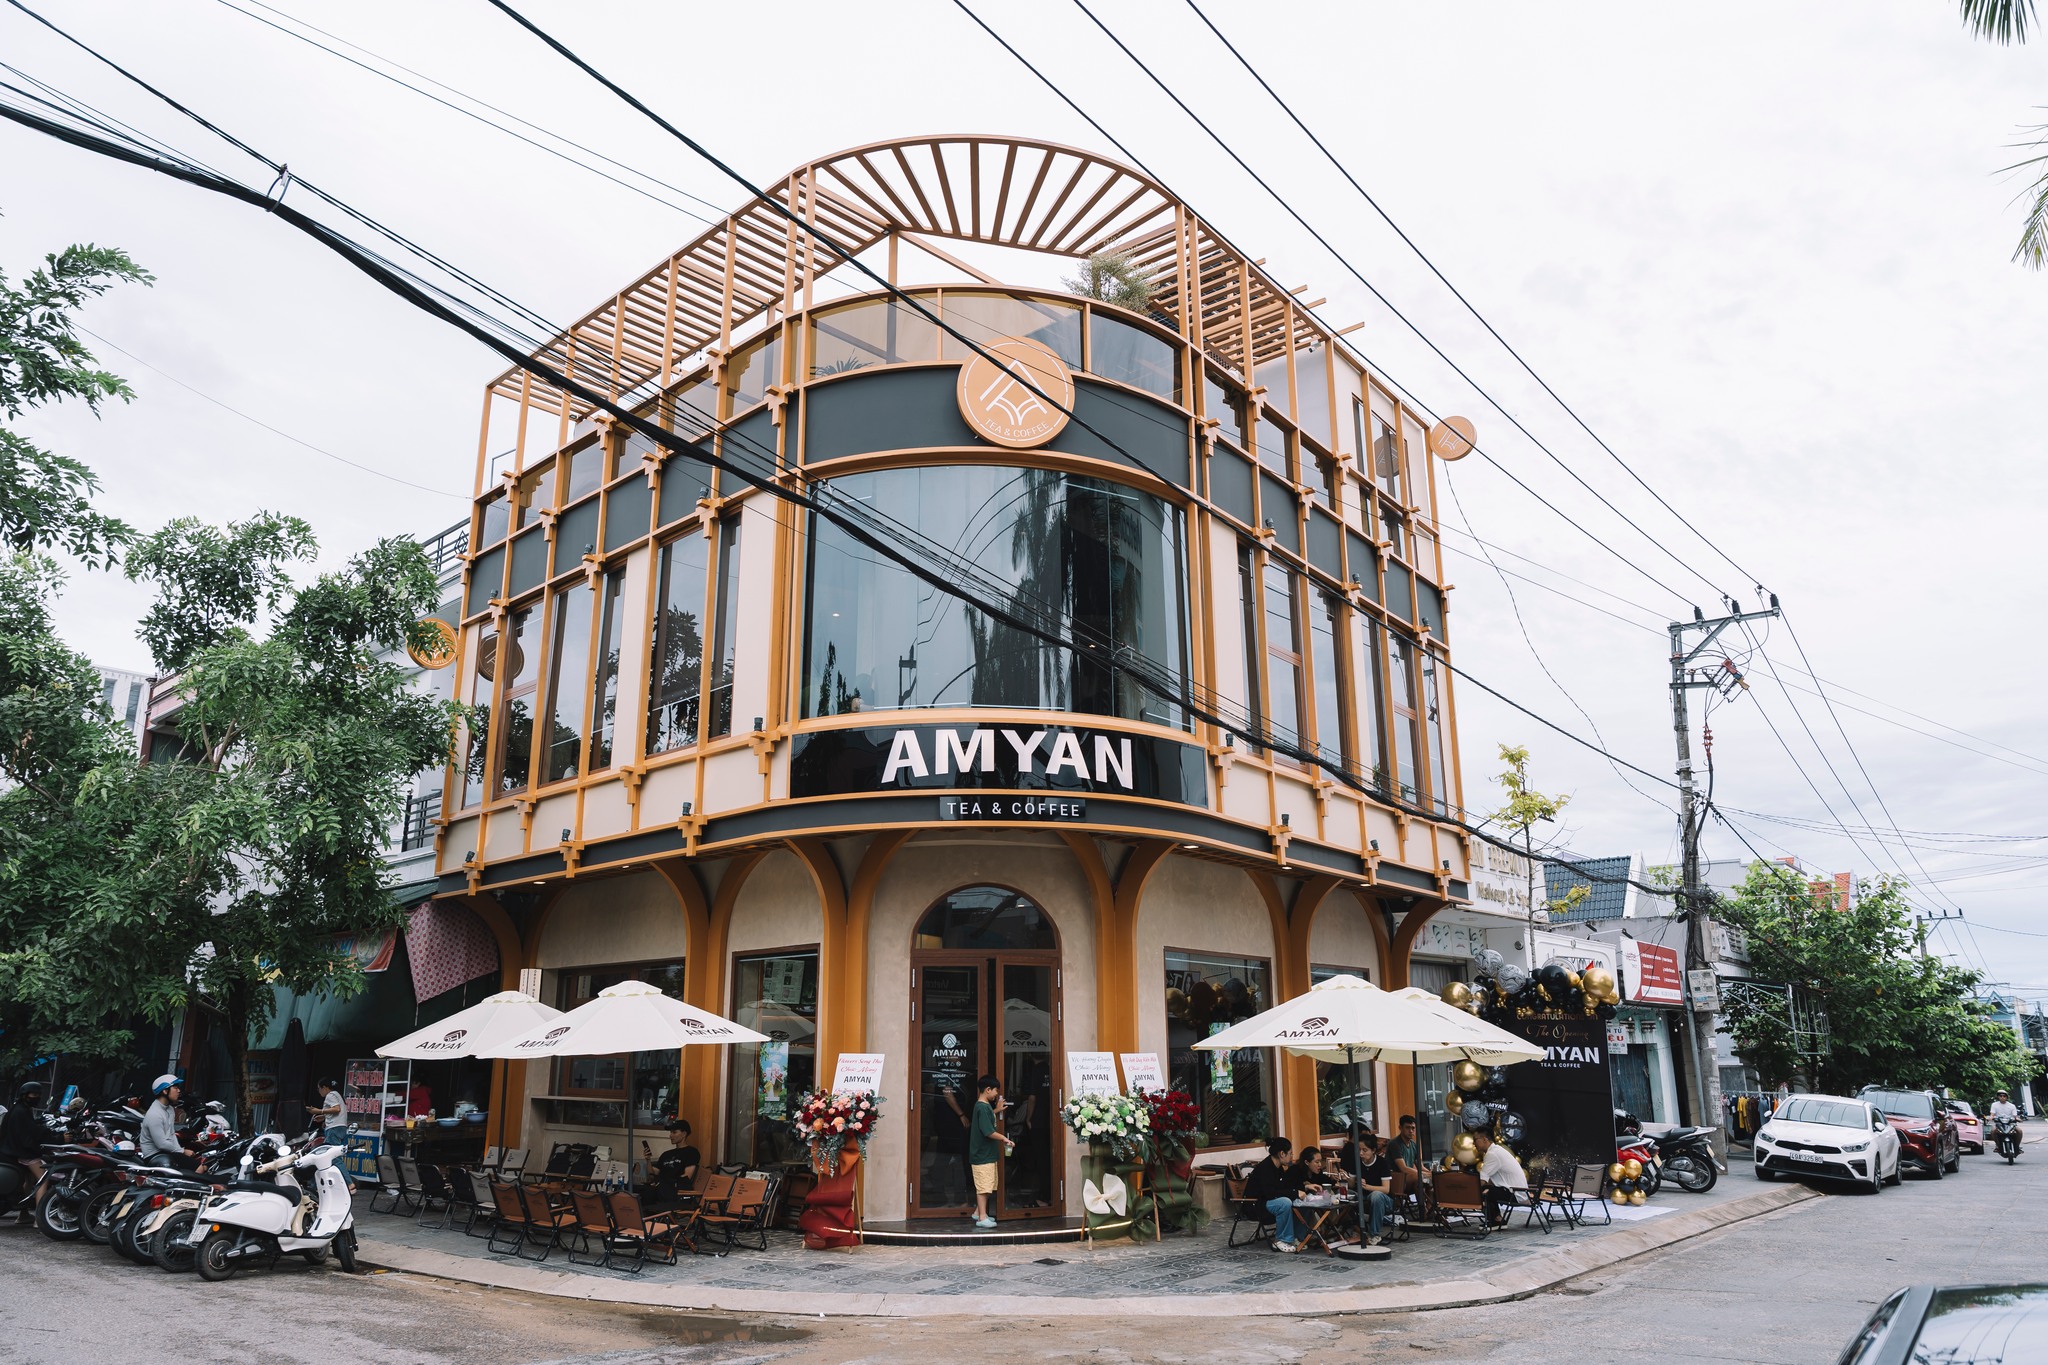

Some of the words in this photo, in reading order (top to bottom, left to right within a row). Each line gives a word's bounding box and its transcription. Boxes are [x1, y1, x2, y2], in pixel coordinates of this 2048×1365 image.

[985, 418, 1002, 432] TEA
[1014, 421, 1049, 438] COFFEE
[881, 728, 1134, 790] AMYAN
[947, 802, 982, 815] TEA
[992, 802, 1002, 815] &
[1012, 802, 1080, 818] COFFEE
[1274, 1028, 1340, 1038] AMYAN
[416, 1042, 466, 1050] AMYAN
[514, 1039, 562, 1048] AMYAN
[932, 1050, 967, 1058] AMYAN
[1538, 1046, 1600, 1064] MYAN
[844, 1076, 872, 1084] AMYAN
